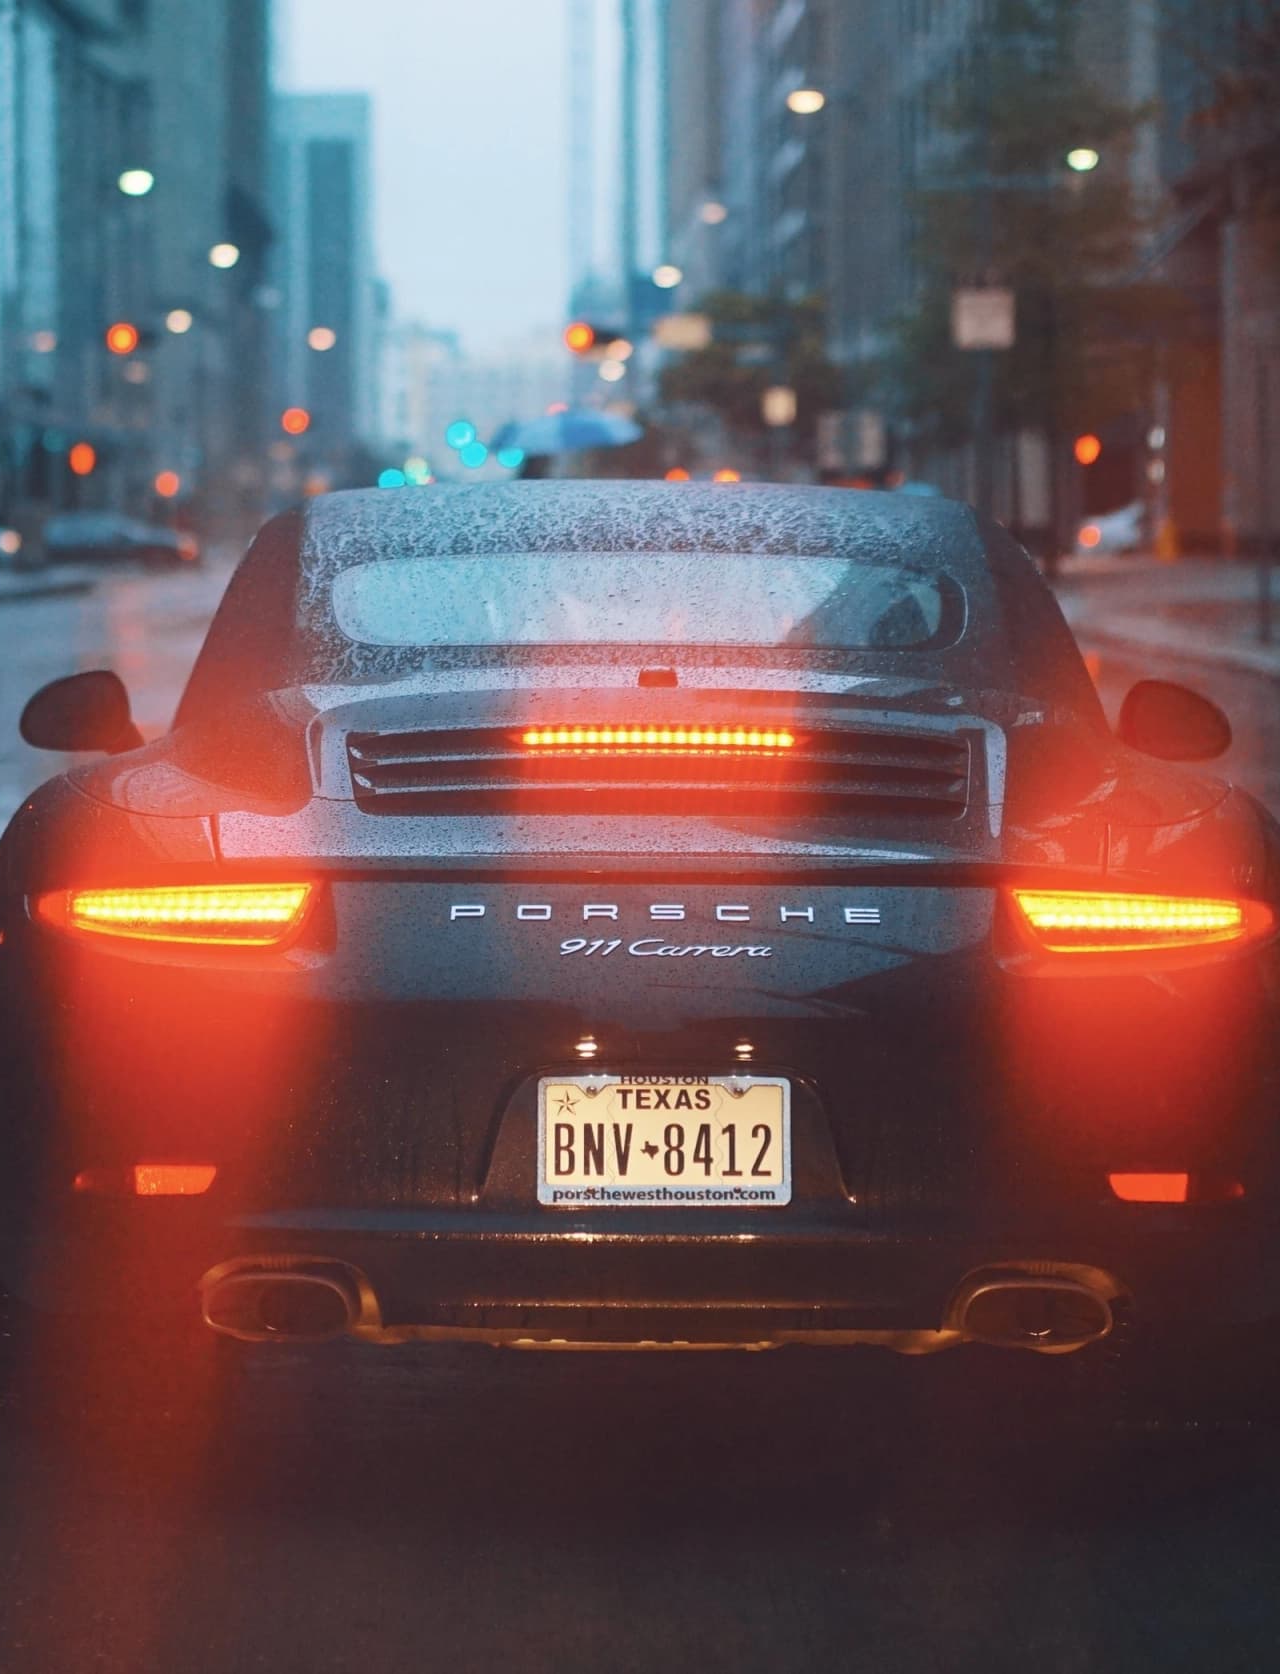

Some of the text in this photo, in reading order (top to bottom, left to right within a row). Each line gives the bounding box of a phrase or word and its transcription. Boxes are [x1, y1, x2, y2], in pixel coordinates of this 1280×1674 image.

[450, 904, 881, 924] PORSCHE
[560, 938, 773, 957] 911 Carrera
[620, 1075, 709, 1085] HOUSTON
[616, 1088, 712, 1110] TEXAS
[552, 1187, 776, 1202] porschewesthouston.com
